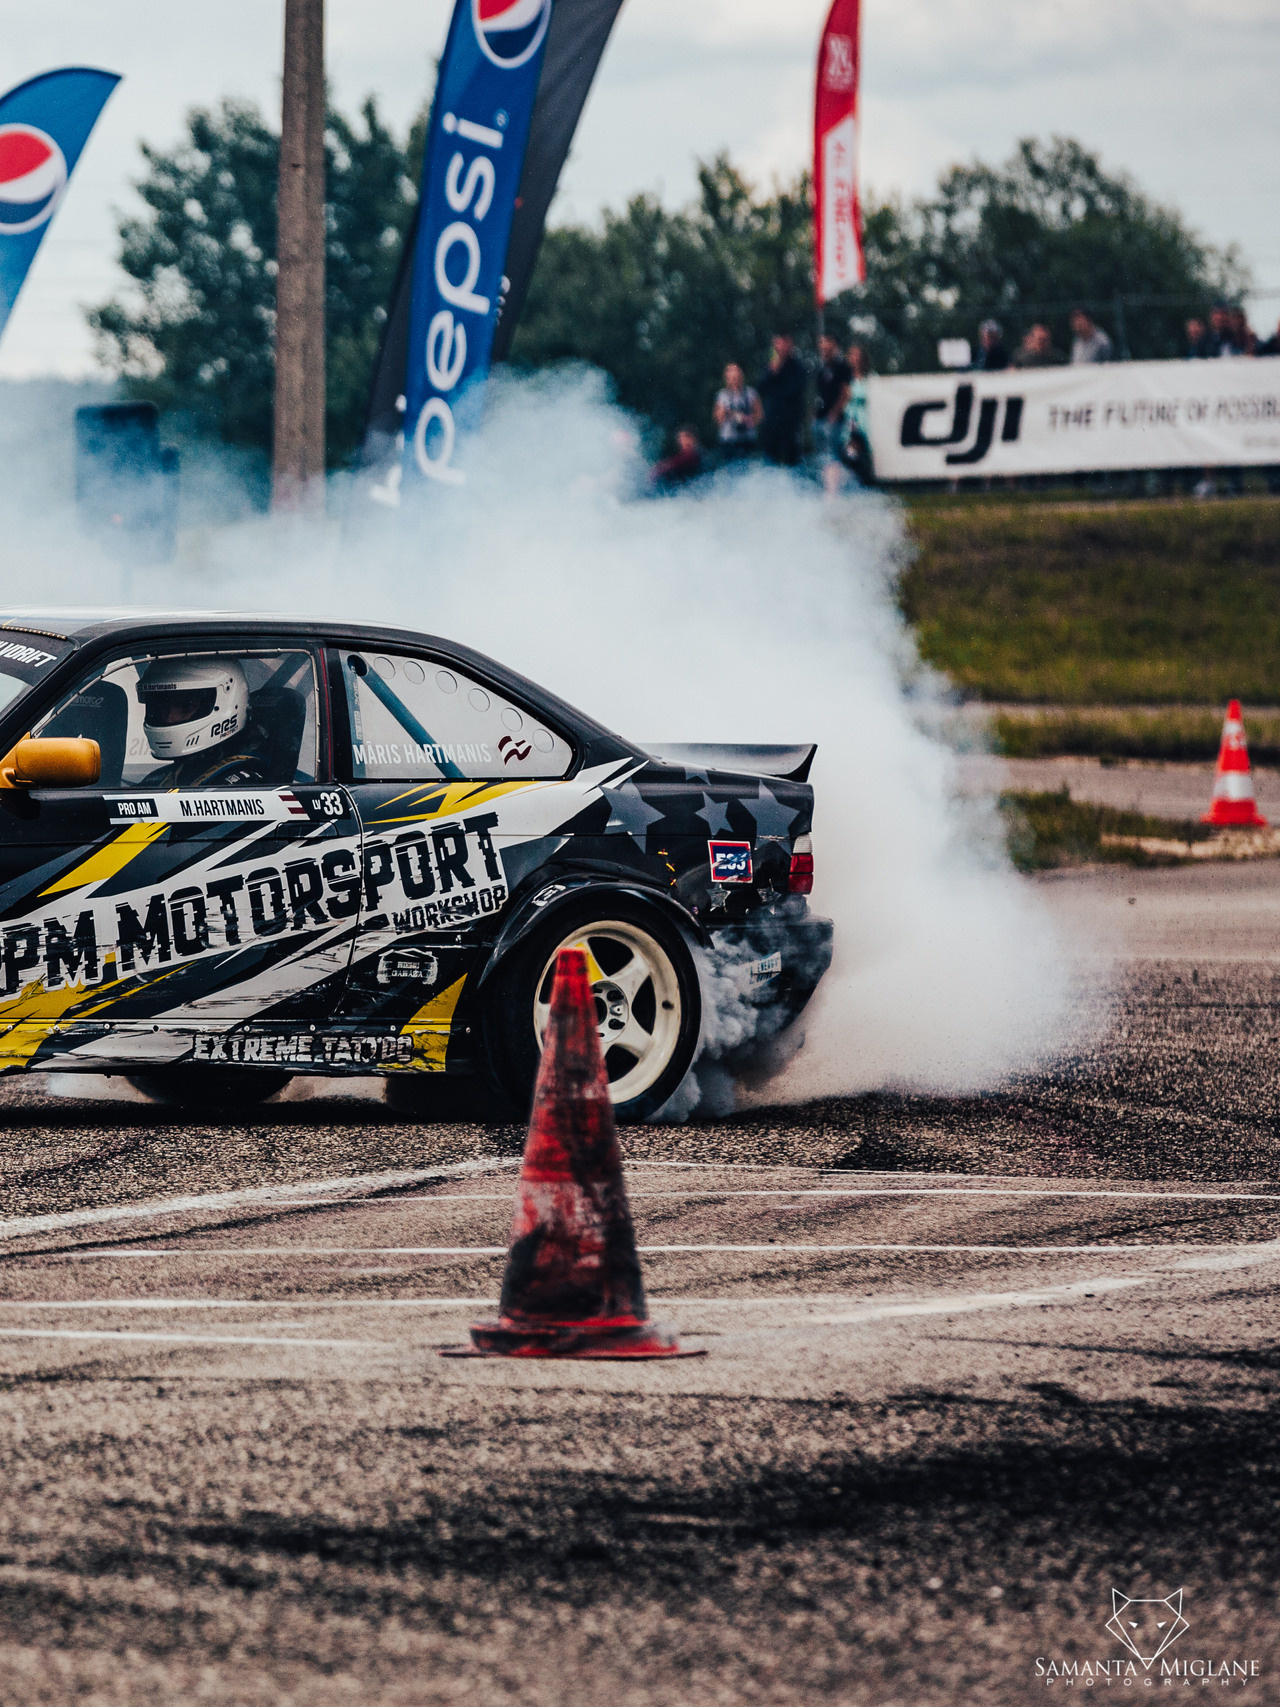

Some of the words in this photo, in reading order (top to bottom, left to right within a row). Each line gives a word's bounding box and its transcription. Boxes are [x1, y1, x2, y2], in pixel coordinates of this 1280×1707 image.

[414, 111, 504, 486] pepsi
[210, 714, 239, 738] RRS
[353, 740, 402, 765] MĀRIS
[406, 743, 492, 764] HARTMANIS
[117, 802, 137, 815] PRO
[137, 801, 152, 815] AM
[180, 799, 265, 817] M.HARTMANIS
[323, 792, 343, 816] 33
[392, 884, 506, 934] WORKSHOP
[194, 1034, 313, 1062] EXTREME
